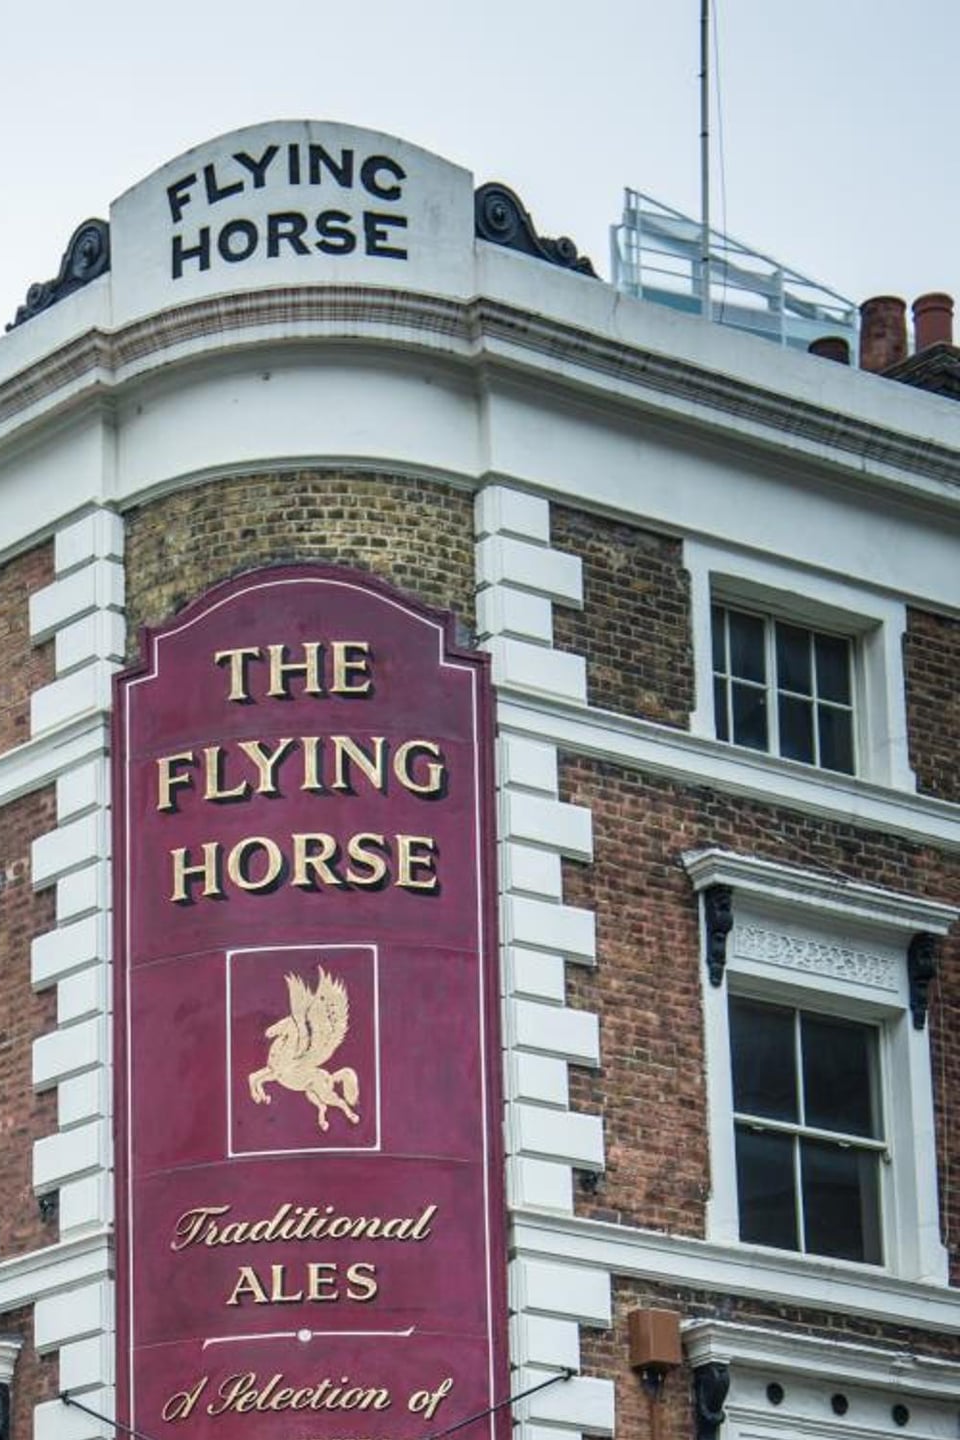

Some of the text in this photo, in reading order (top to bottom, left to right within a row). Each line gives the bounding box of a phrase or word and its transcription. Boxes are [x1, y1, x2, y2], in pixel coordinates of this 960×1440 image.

[171, 209, 408, 280] HORSE
[214, 641, 372, 702] THE
[155, 736, 445, 812] FLYING
[169, 833, 438, 902] HORSE
[171, 1203, 438, 1251] Traditional
[226, 1262, 378, 1305] ALES
[161, 1372, 454, 1422] A Selection of
